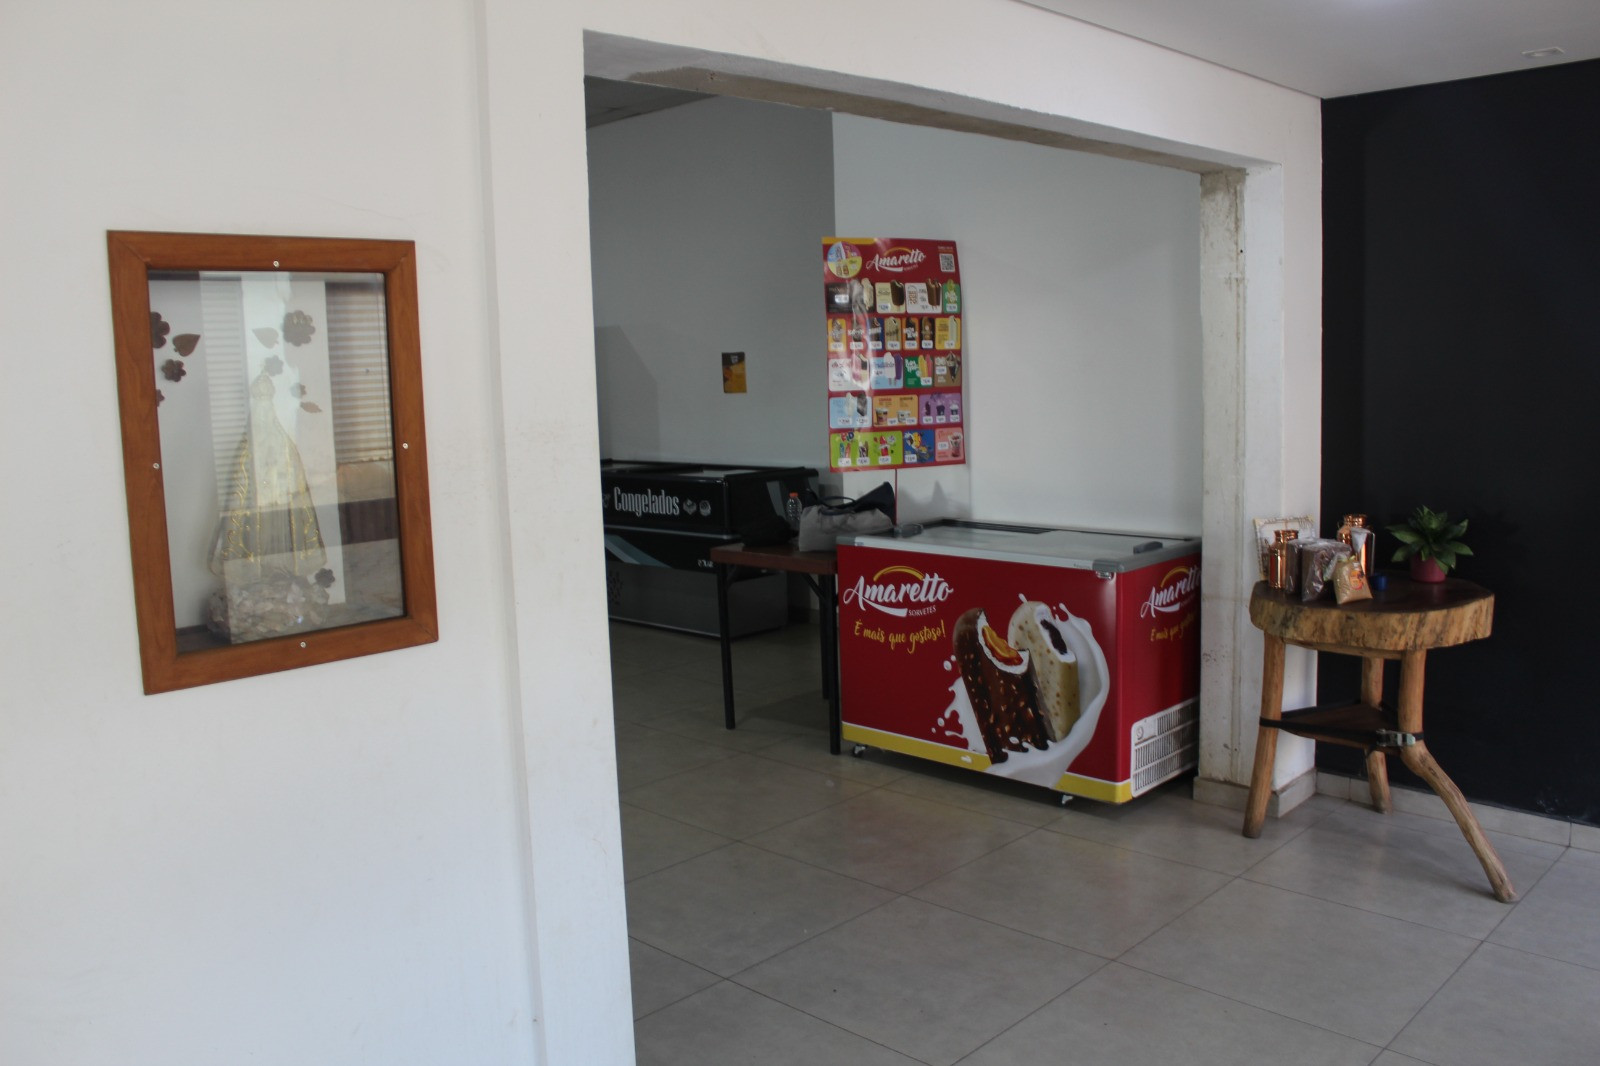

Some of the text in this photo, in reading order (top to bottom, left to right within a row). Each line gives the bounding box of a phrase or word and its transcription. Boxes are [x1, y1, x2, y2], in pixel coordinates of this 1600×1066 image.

[866, 248, 926, 272] Amaretto
[613, 486, 680, 517] Congelados
[843, 572, 954, 617] Amaretto
[908, 604, 937, 617] SORVETES
[863, 624, 885, 643] mais
[888, 632, 906, 650] que
[907, 618, 947, 654] gostoso!
